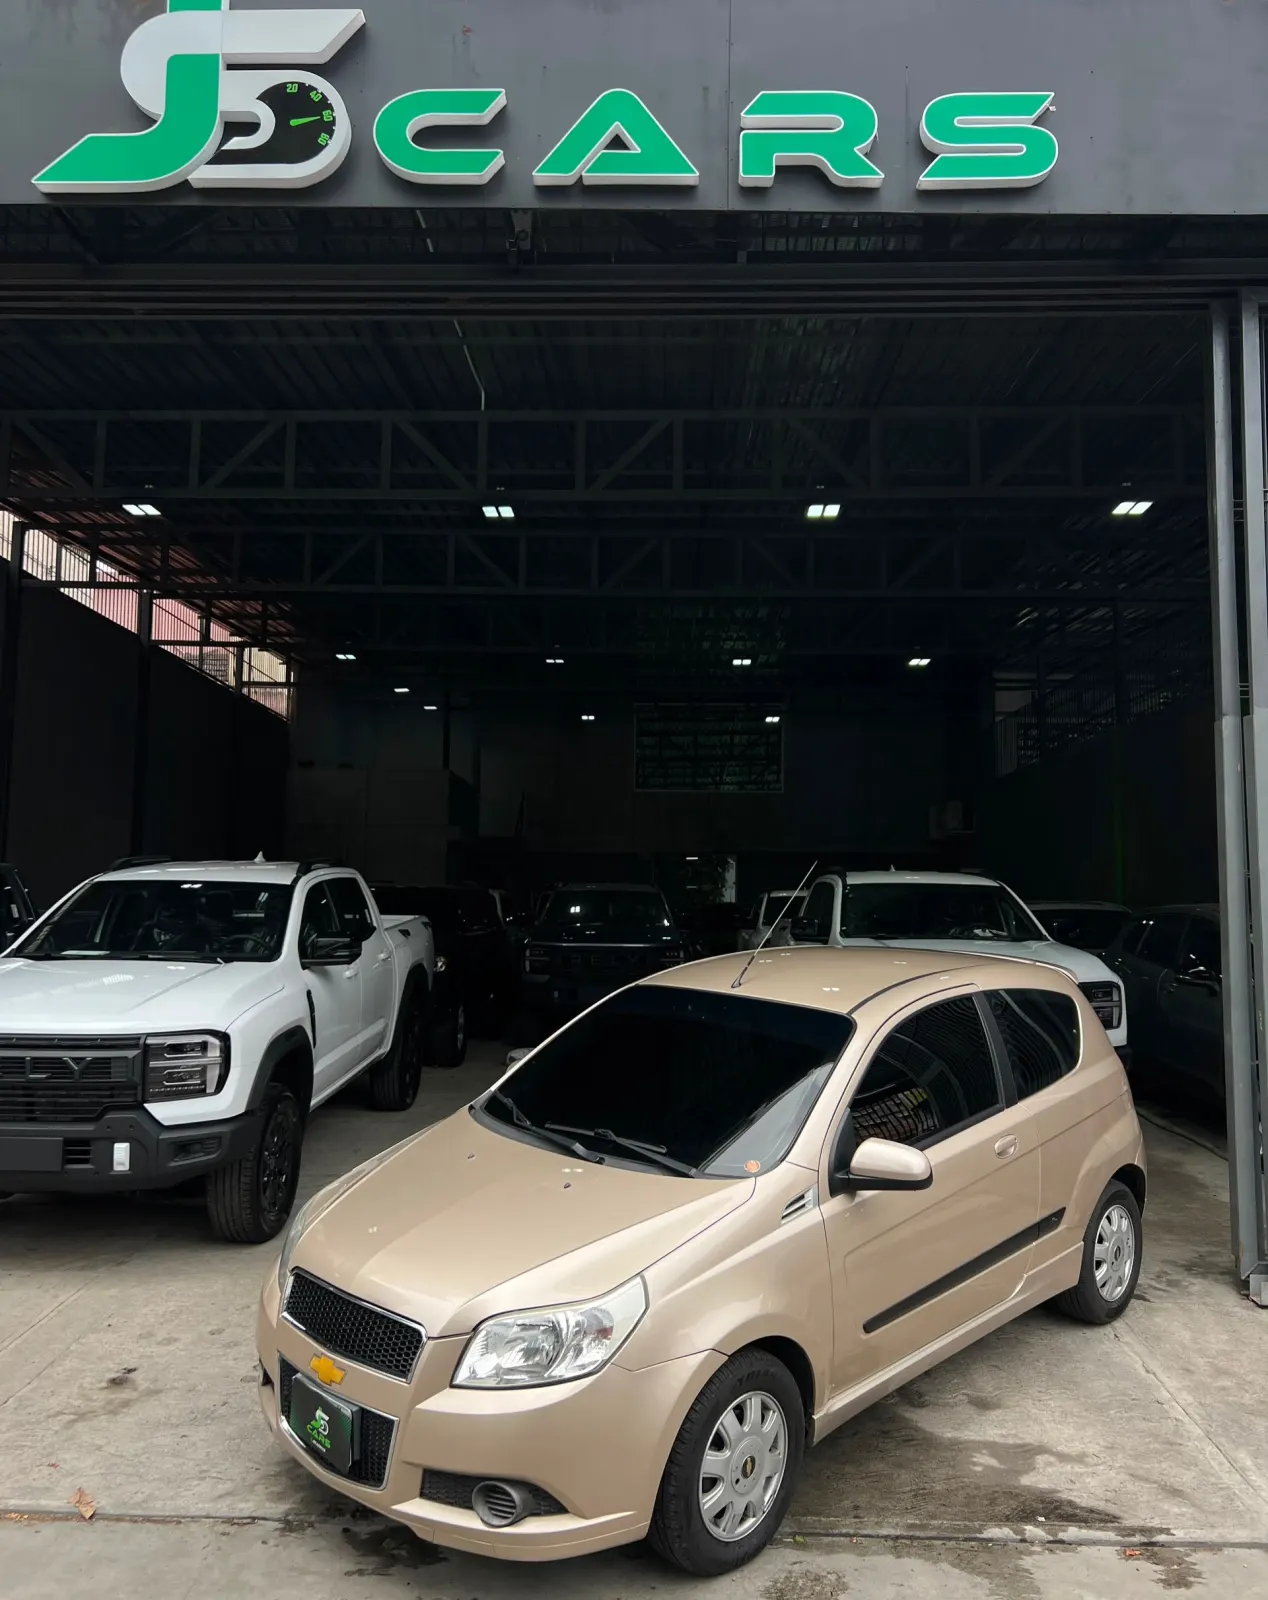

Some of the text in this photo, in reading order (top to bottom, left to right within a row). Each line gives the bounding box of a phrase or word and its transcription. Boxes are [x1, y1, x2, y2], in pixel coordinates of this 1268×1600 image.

[286, 83, 299, 93] 20
[309, 90, 323, 102] 40
[322, 109, 333, 122] 60
[317, 132, 330, 146] 80
[373, 88, 1058, 189] CARS
[0, 1056, 94, 1081] LY
[306, 1424, 331, 1449] CARS
